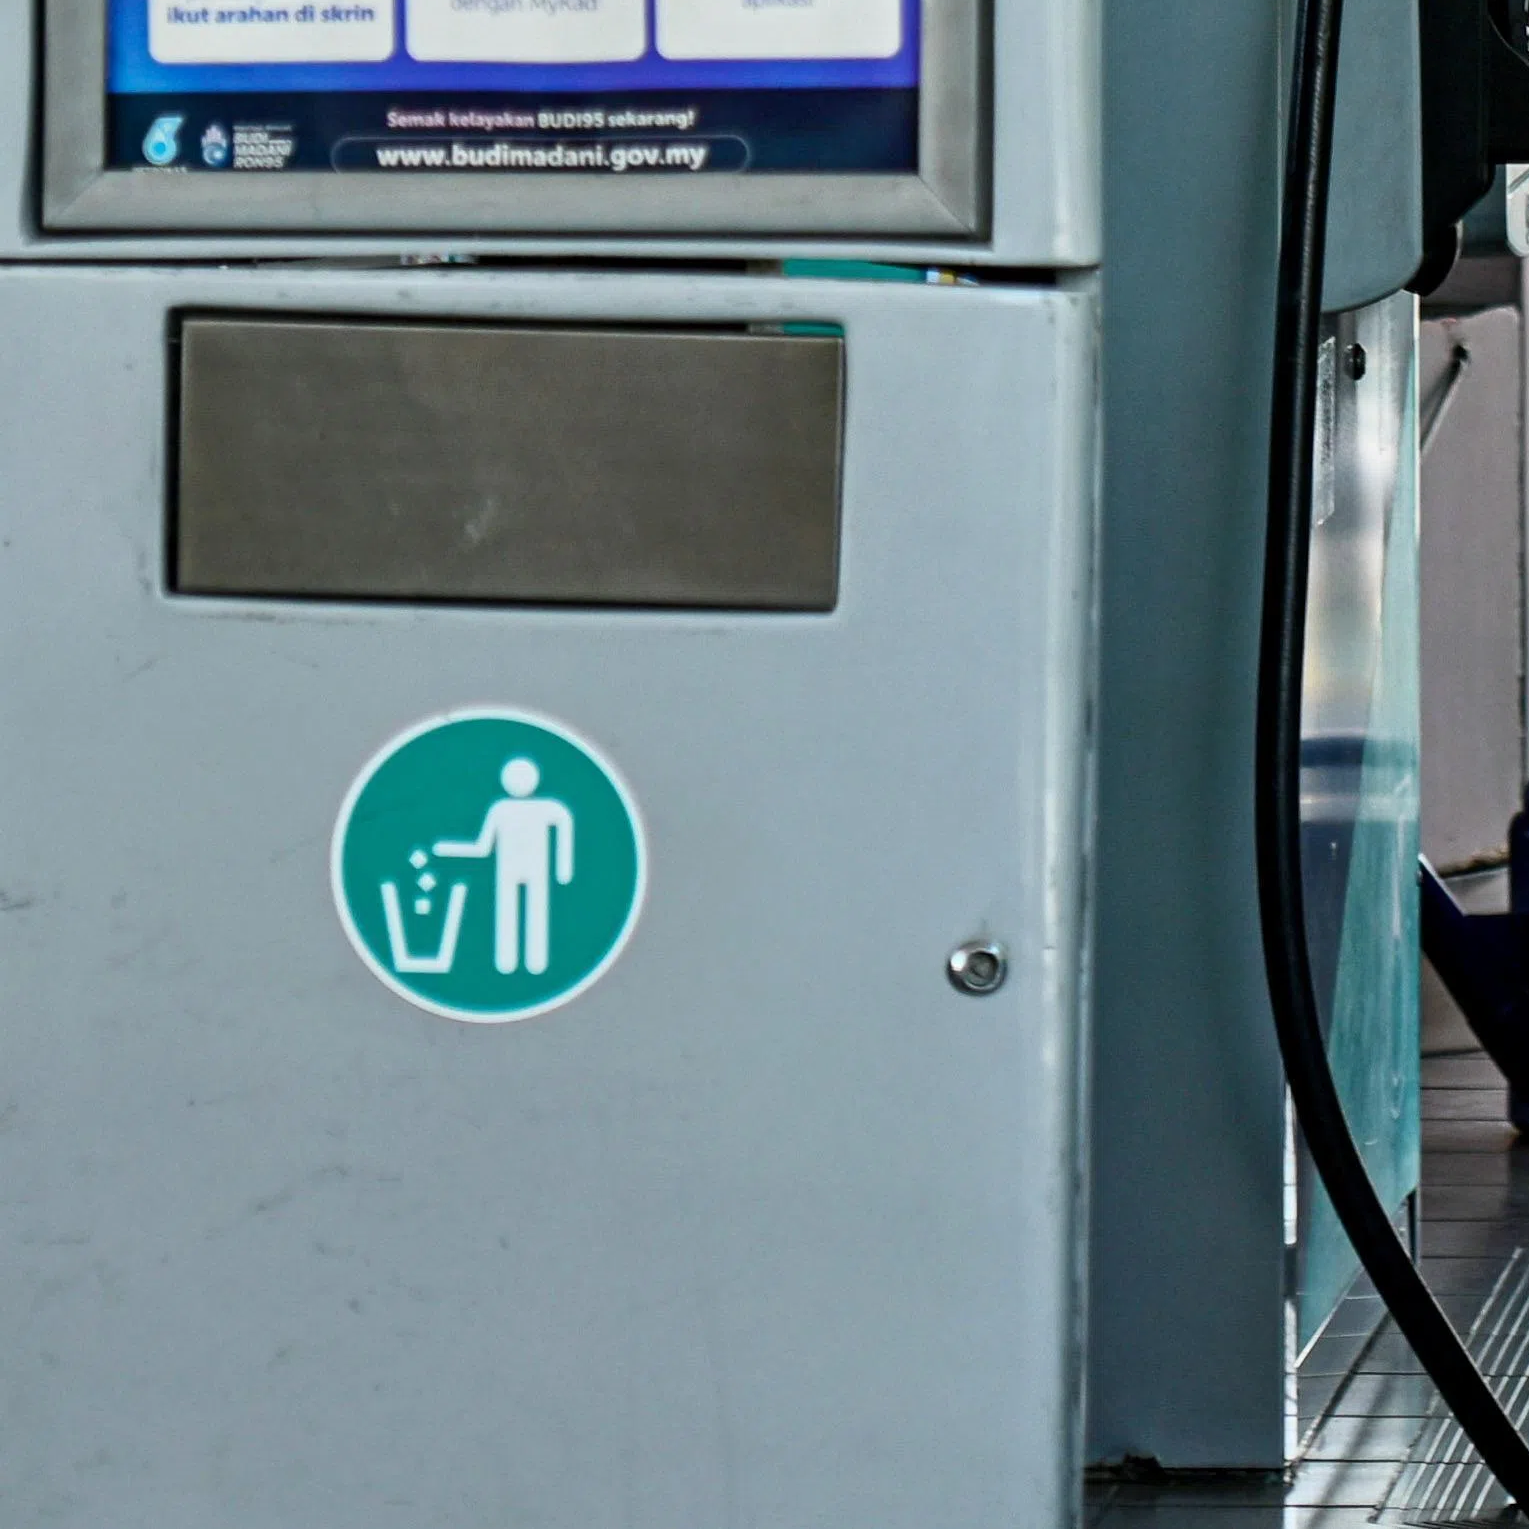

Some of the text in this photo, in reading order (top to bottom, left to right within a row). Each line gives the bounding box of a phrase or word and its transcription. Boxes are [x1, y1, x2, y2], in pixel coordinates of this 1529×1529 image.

[168, 5, 374, 24] ikut arahan di skrin
[387, 110, 695, 131] Semak kelayakan BUDI95 sekarang!
[376, 144, 706, 171] www.budimadani.gov.my
